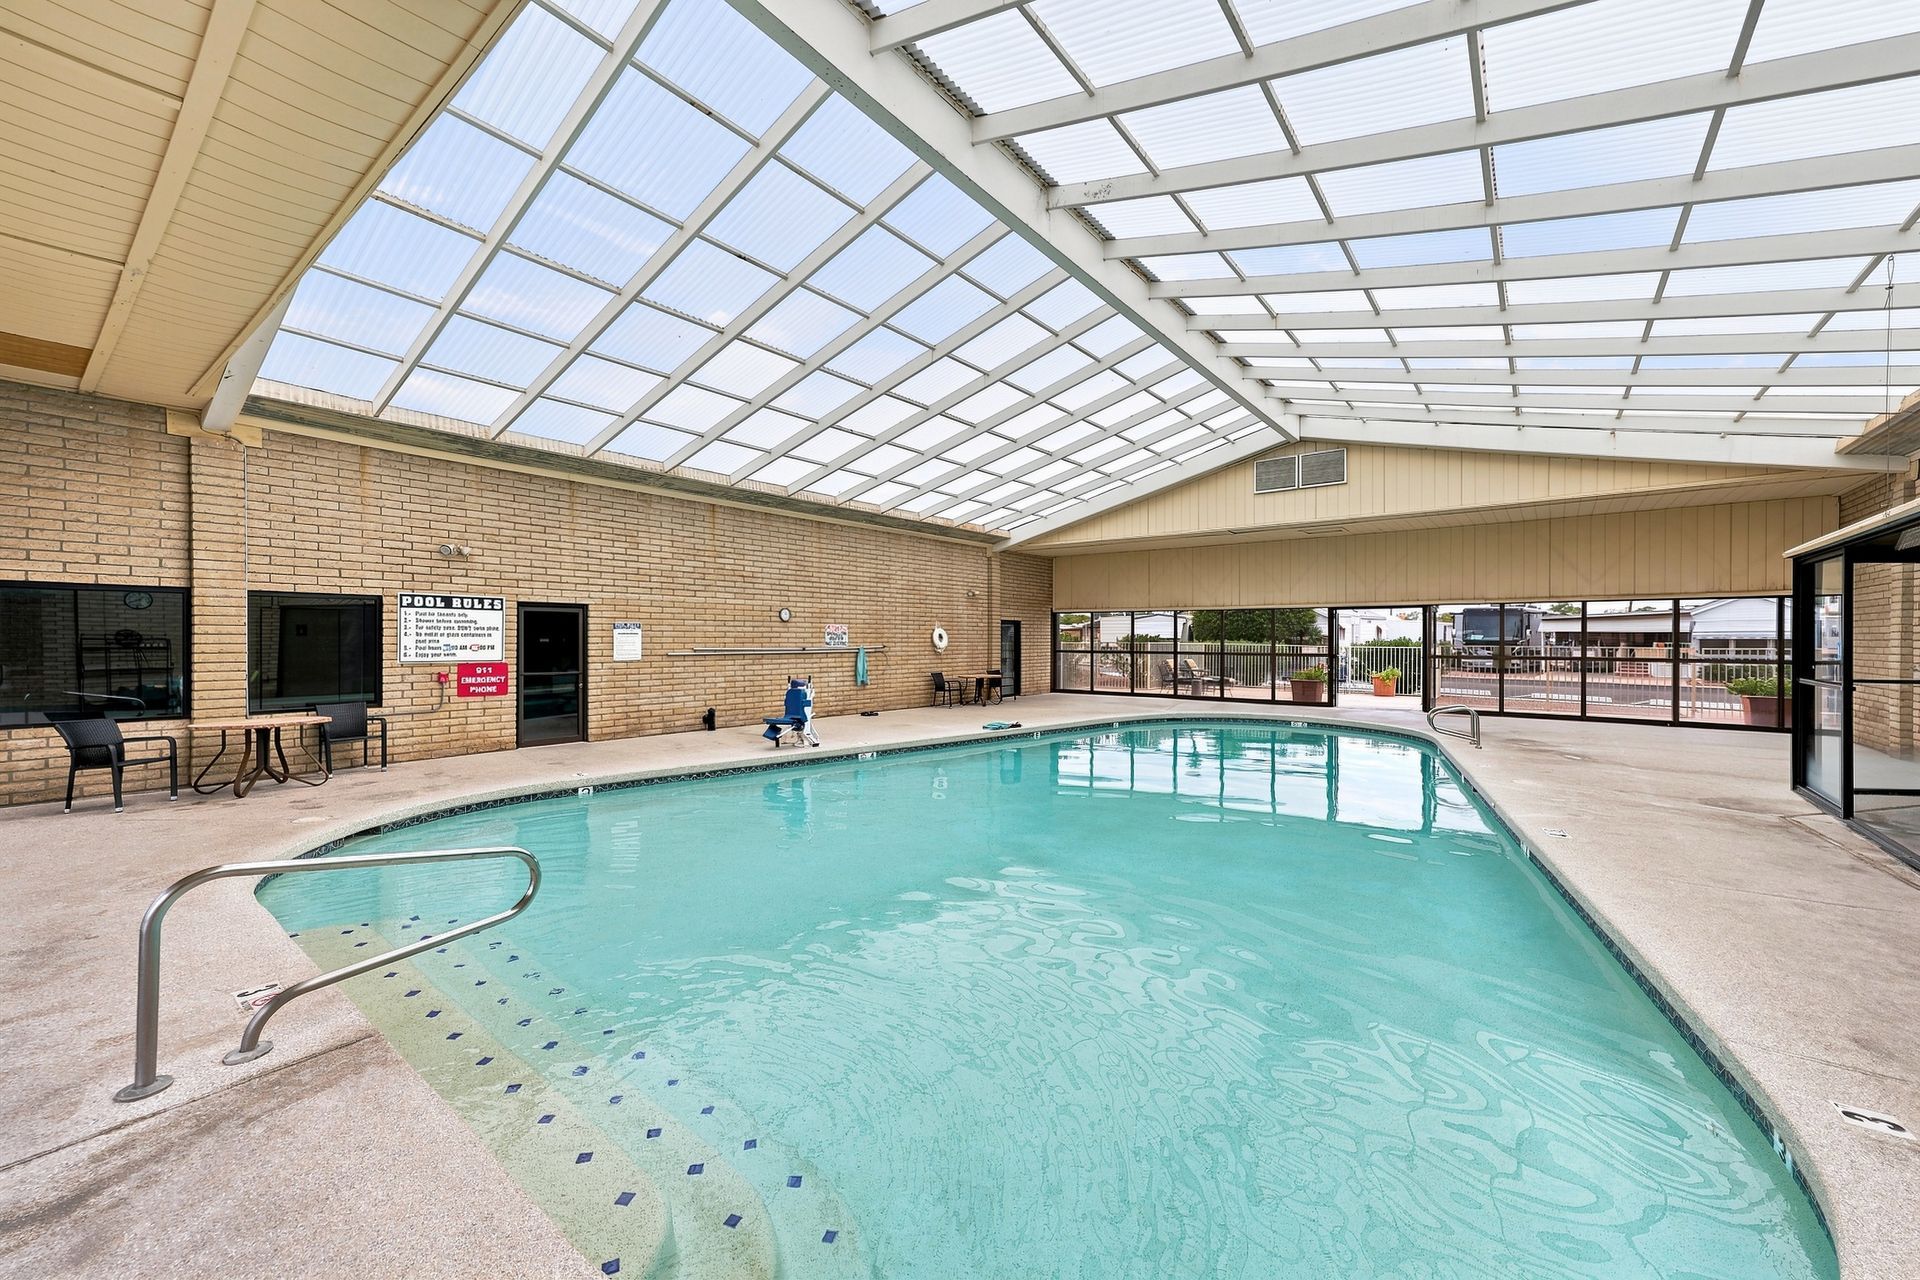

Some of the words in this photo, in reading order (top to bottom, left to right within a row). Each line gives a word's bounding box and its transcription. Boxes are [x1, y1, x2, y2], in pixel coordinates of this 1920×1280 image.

[402, 595, 445, 608] POOL
[452, 598, 502, 609] RULES
[415, 651, 429, 659] Enjoy
[461, 676, 506, 684] EMERGENCY
[470, 685, 497, 693] PHONE
